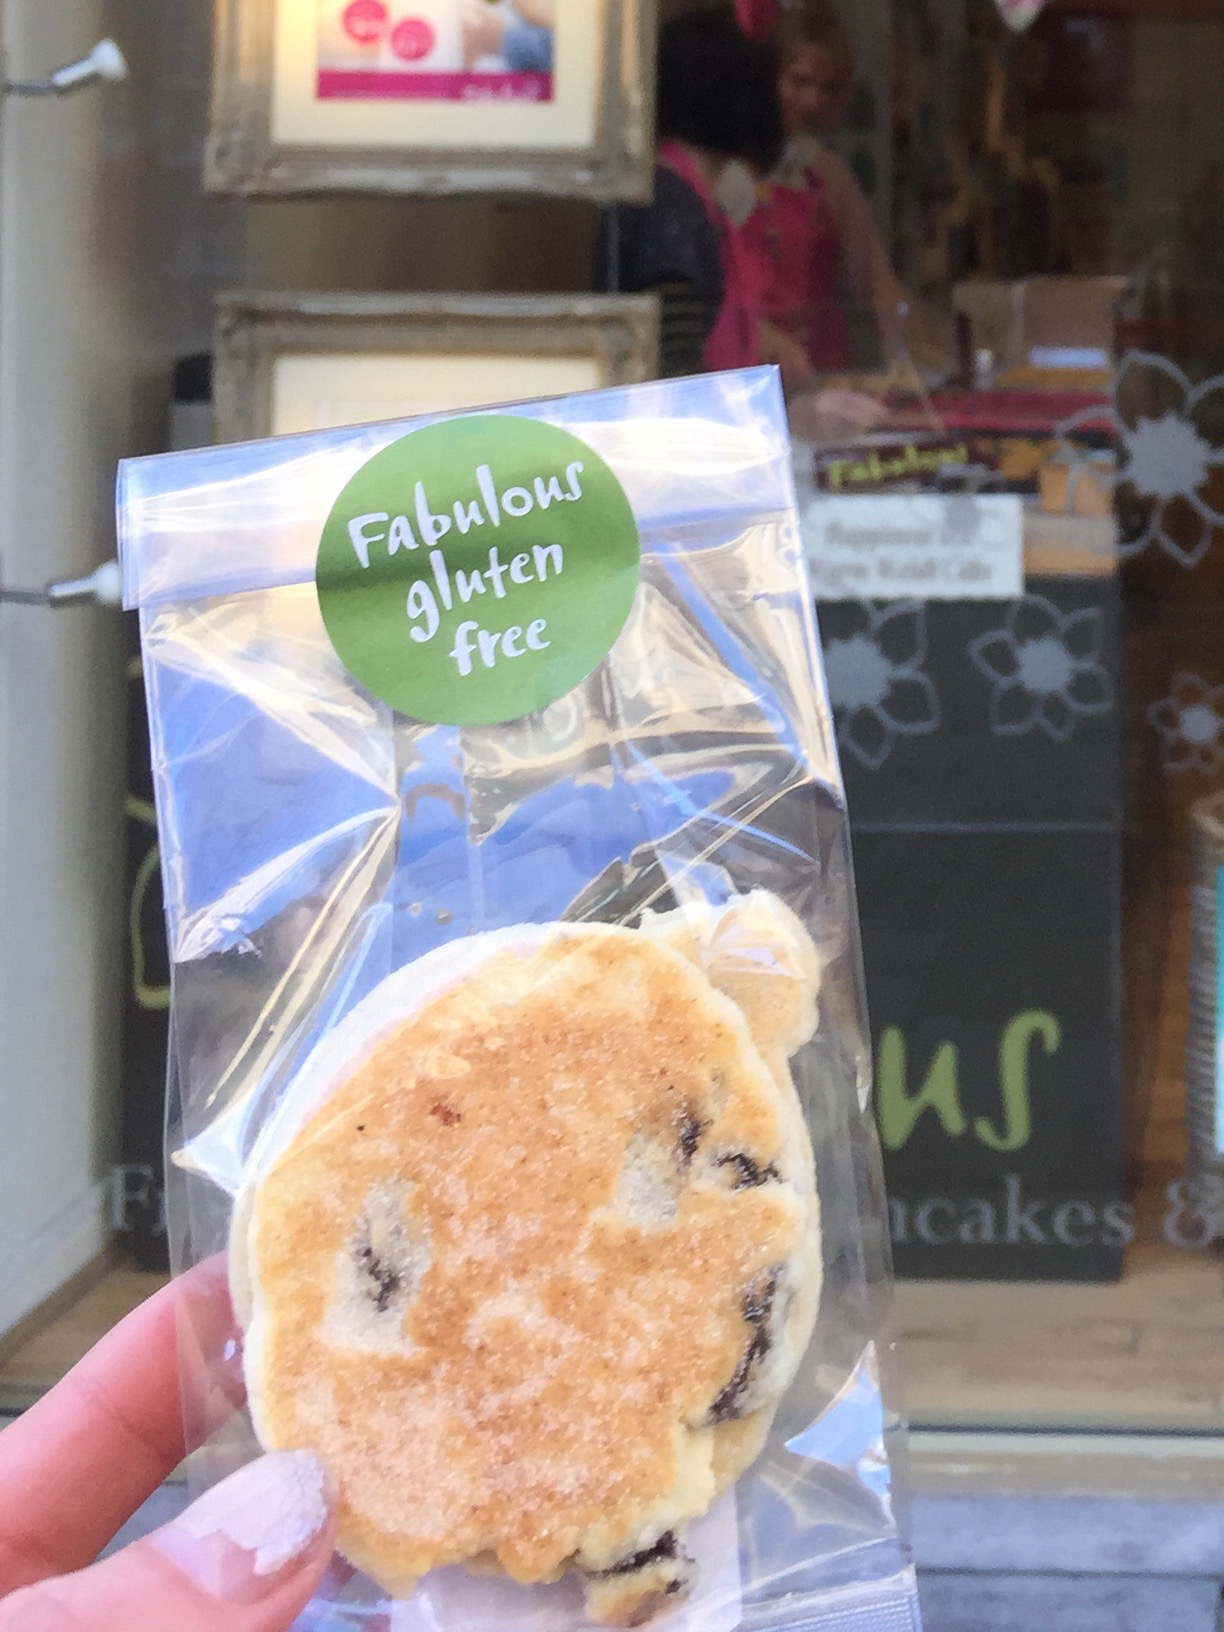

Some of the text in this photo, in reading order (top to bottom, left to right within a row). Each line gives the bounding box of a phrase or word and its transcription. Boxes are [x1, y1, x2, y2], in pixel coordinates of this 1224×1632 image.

[346, 460, 585, 569] Fabulous
[405, 542, 565, 644] gluten
[448, 617, 552, 678] free
